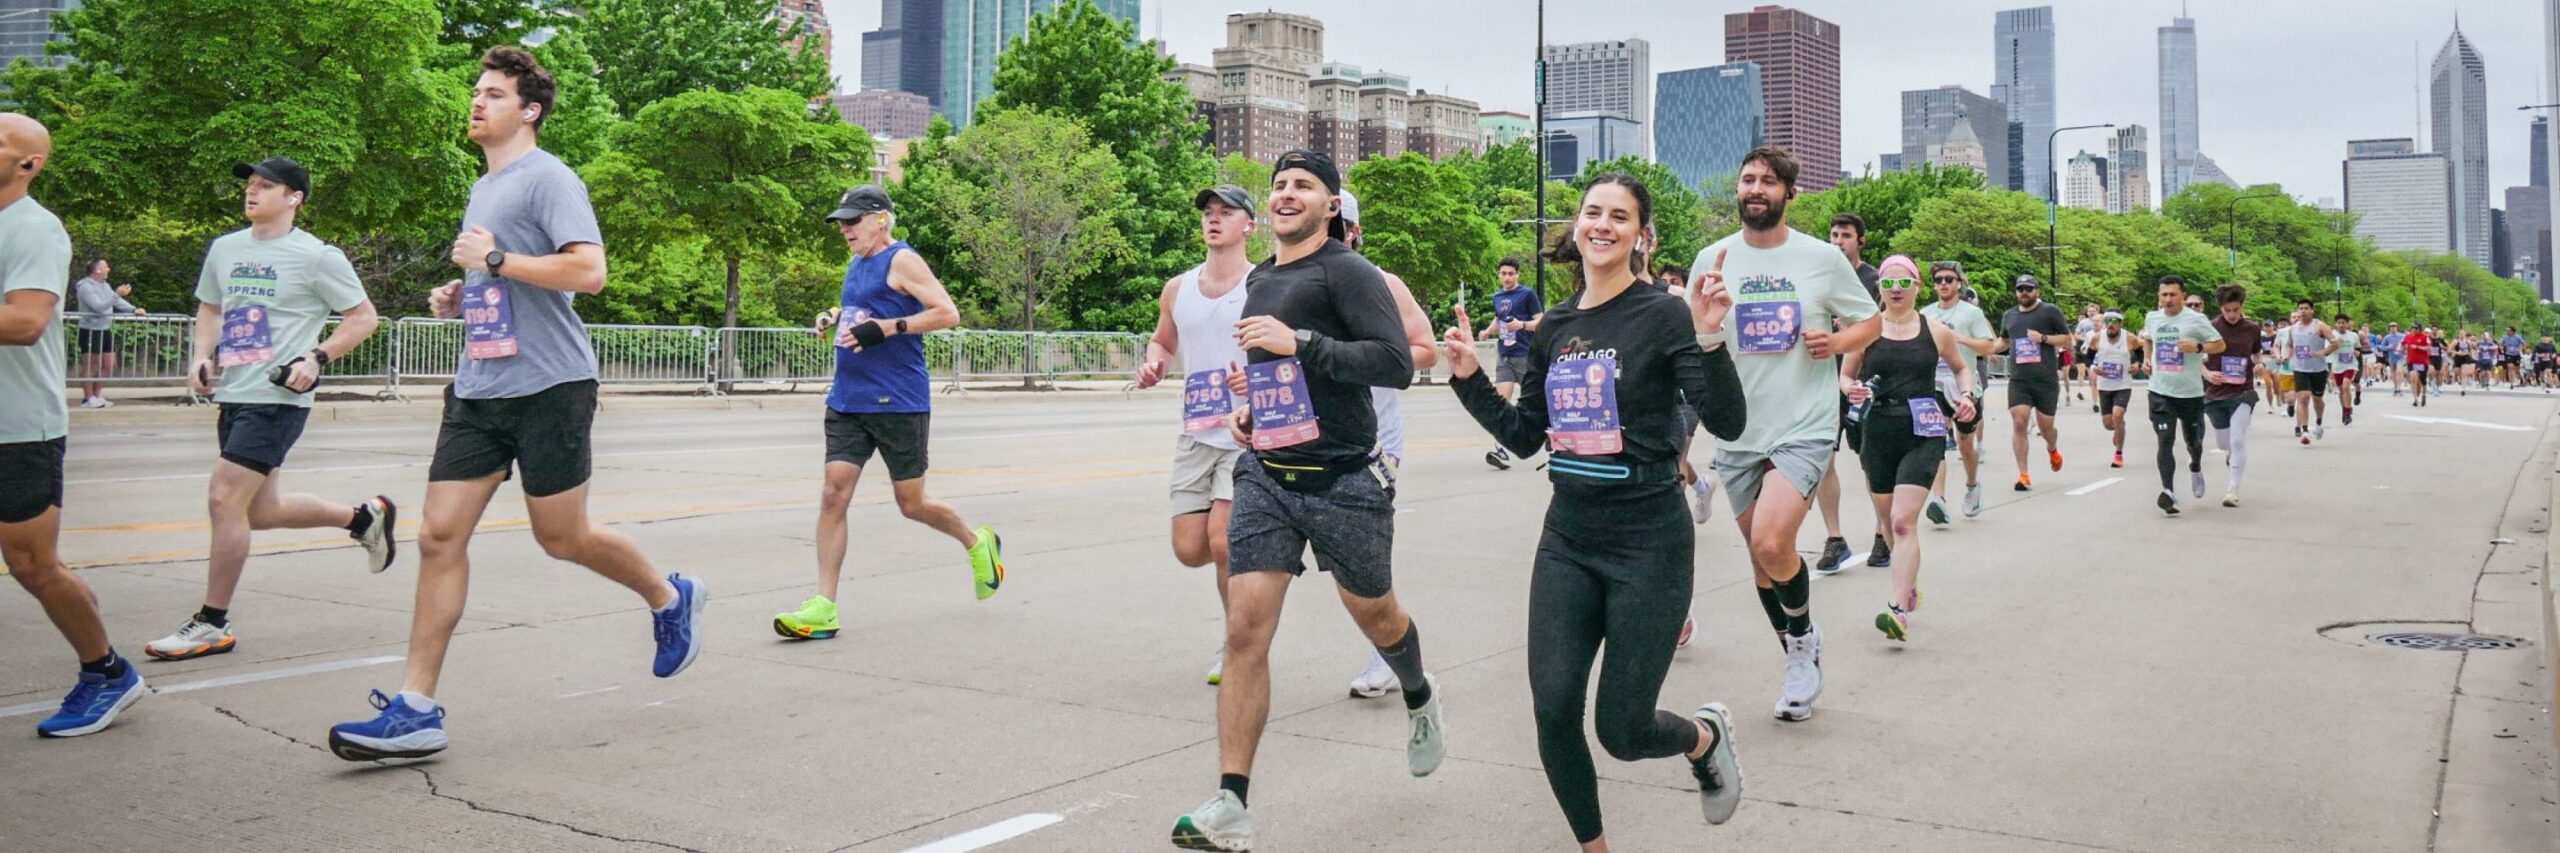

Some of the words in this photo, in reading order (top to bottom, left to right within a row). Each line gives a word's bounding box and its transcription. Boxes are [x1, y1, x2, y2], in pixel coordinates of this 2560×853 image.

[227, 286, 275, 297] SPRING
[1743, 320, 1793, 336] 4504
[1557, 348, 1617, 364] CHICAGO
[1589, 364, 1601, 385] C
[1552, 387, 1602, 409] 3535
